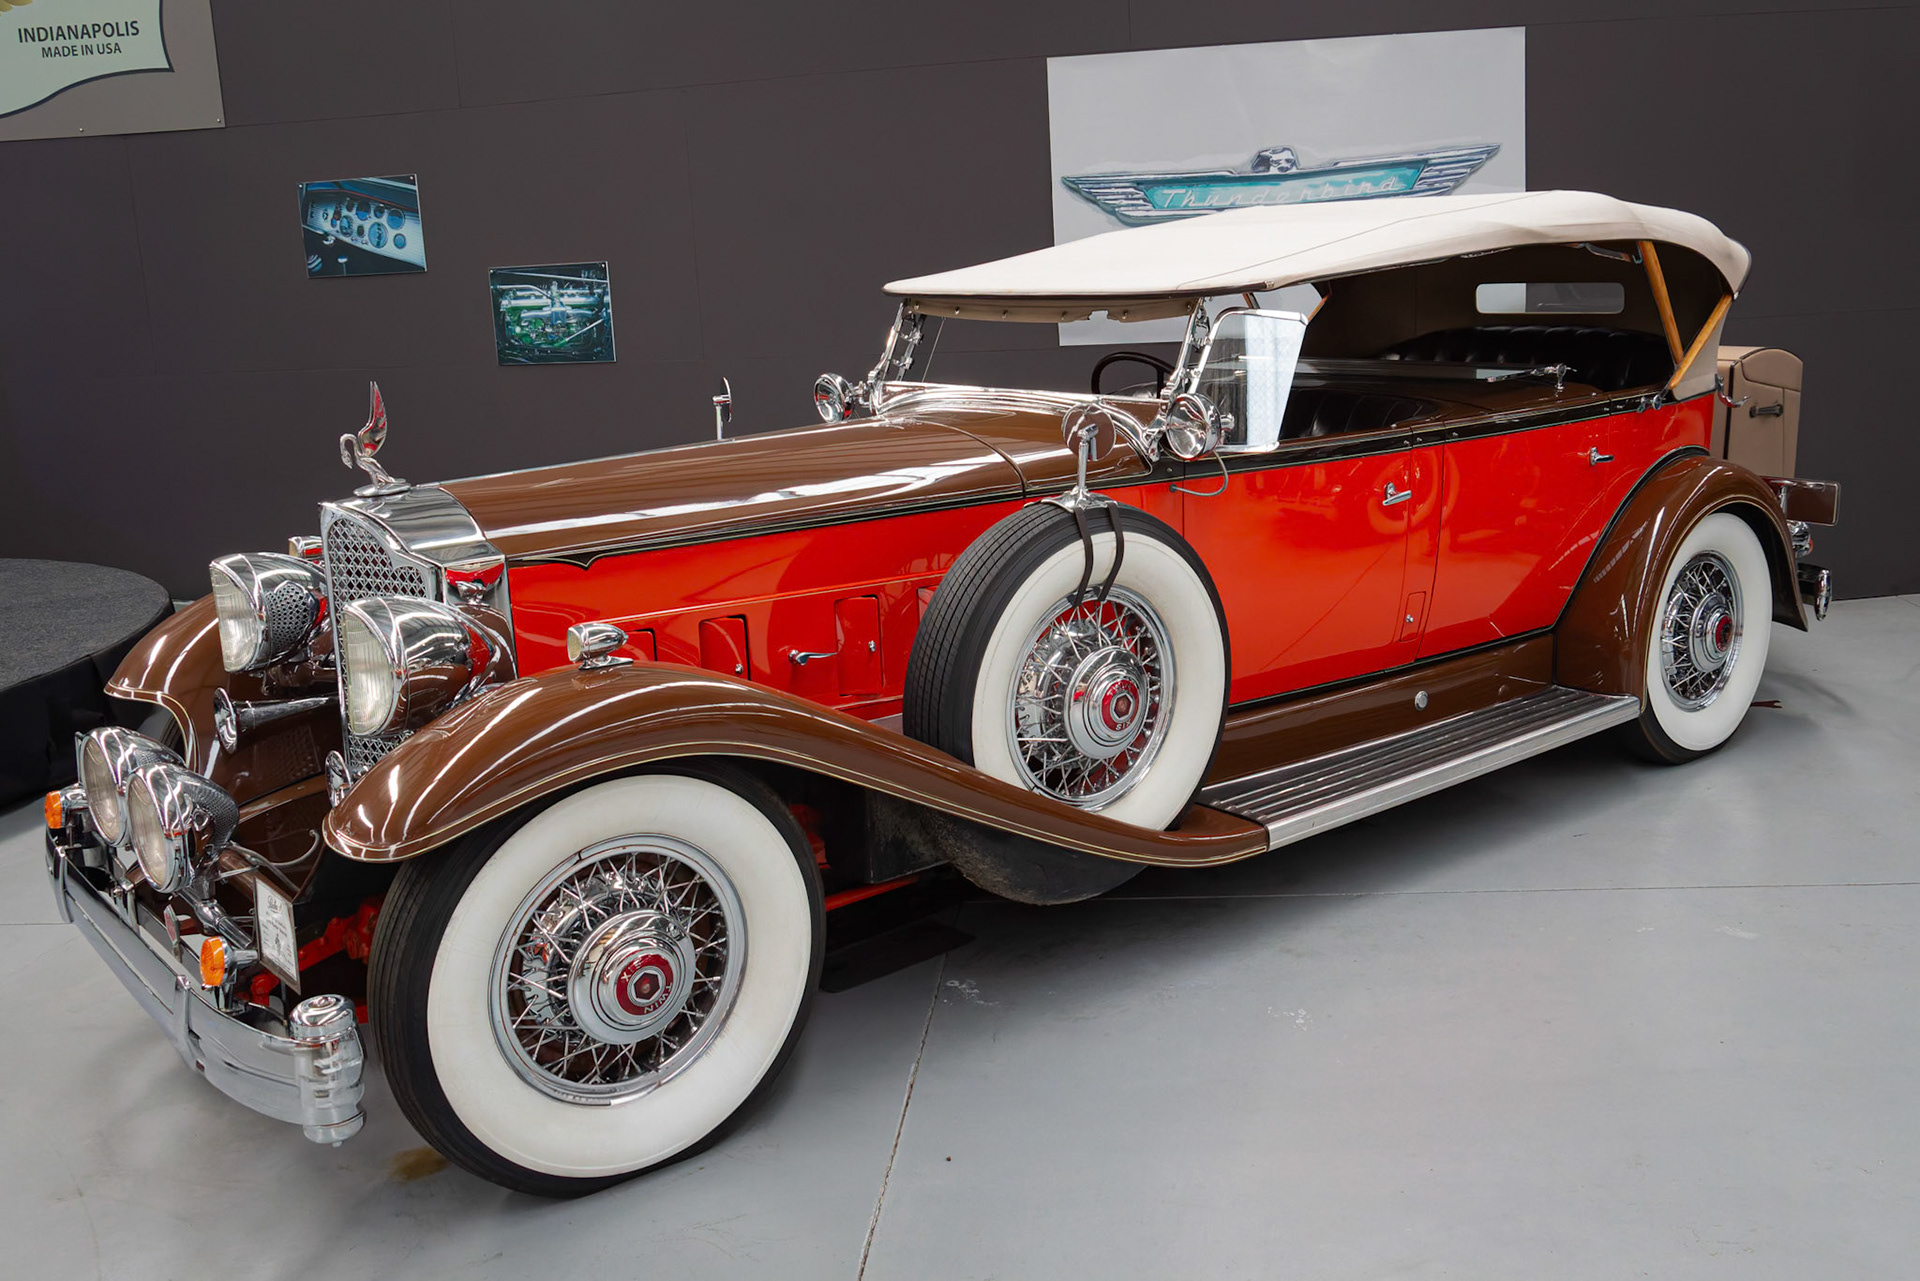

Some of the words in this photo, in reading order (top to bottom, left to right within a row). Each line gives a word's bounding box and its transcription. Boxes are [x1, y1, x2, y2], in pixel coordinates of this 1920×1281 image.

[18, 20, 140, 43] INDIANAPOLIS
[41, 45, 78, 58] MADE
[80, 44, 94, 56] IN
[96, 42, 122, 55] USA
[1162, 176, 1398, 208] Thunderbird
[644, 982, 673, 1012] TWIN
